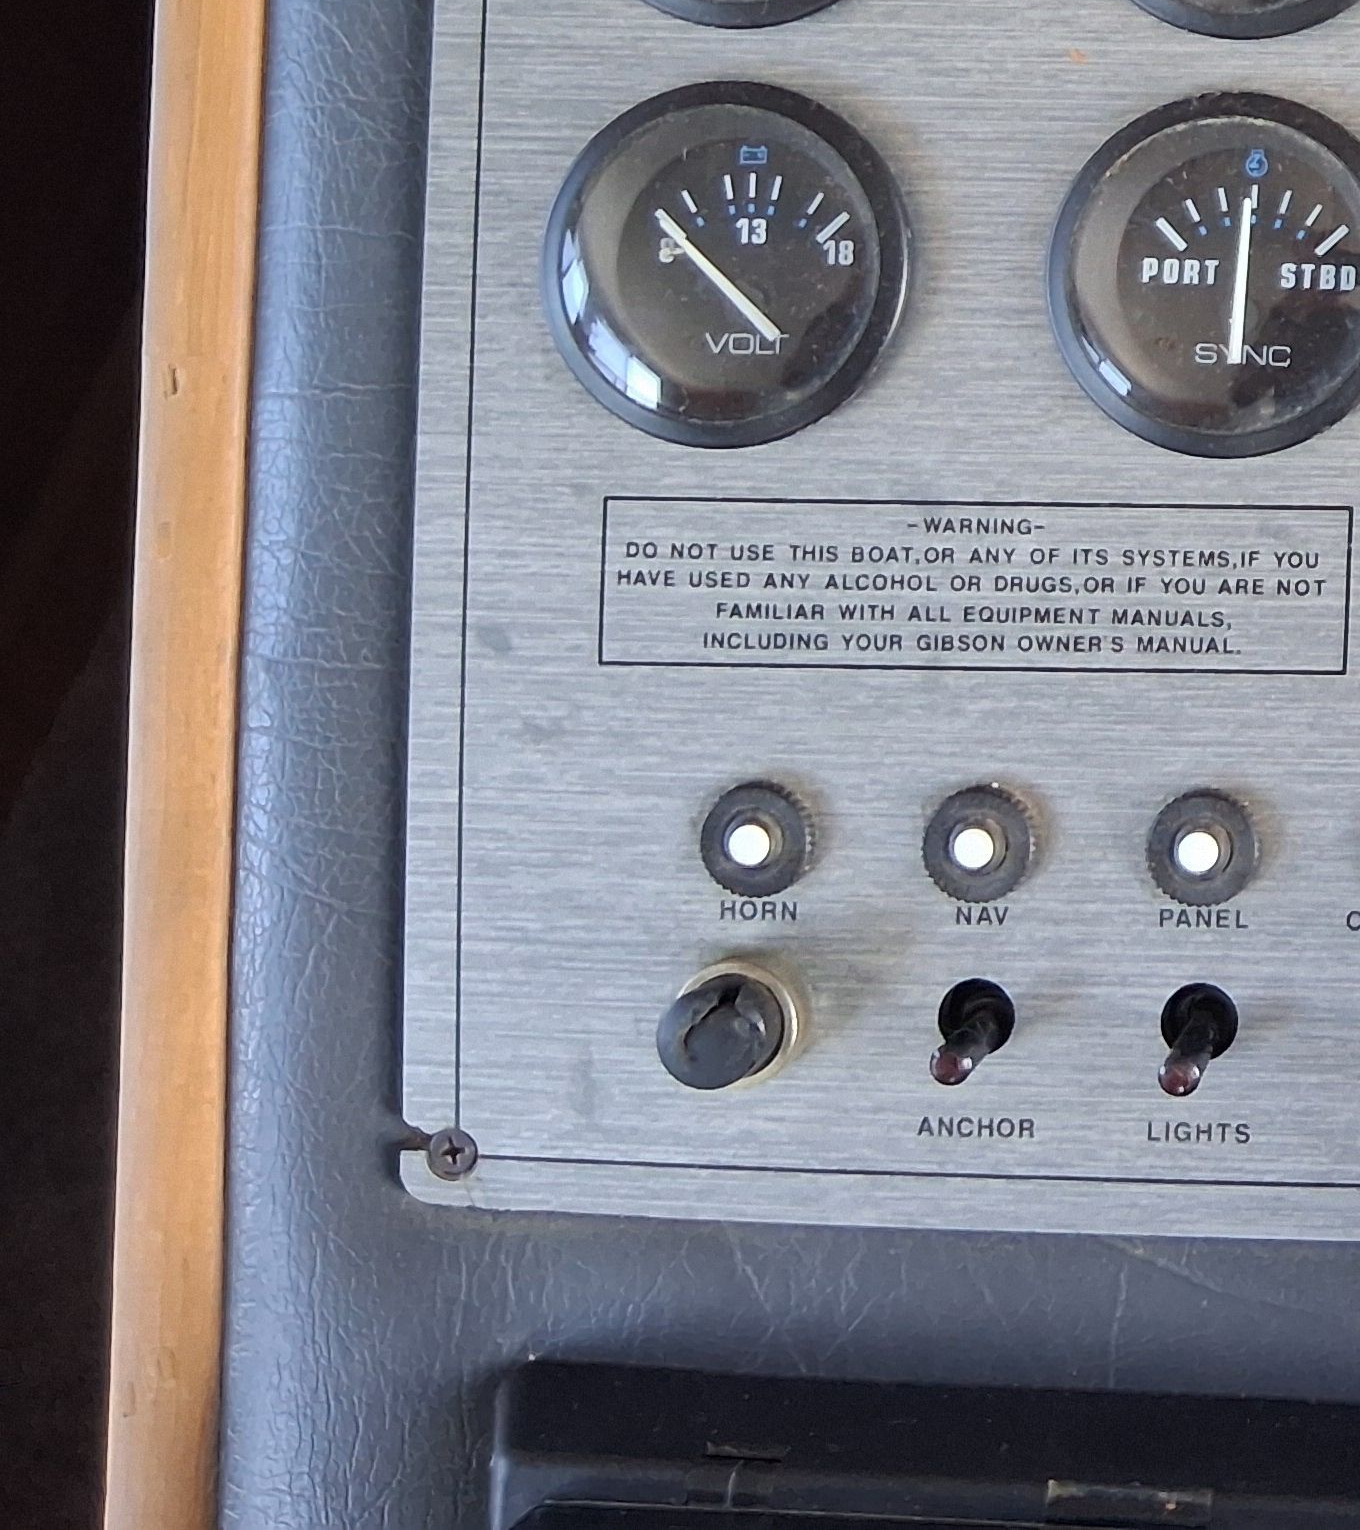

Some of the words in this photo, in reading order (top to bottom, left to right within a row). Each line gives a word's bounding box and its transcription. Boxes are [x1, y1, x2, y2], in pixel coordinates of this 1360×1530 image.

[736, 217, 767, 245] 13
[823, 239, 855, 266] 18
[1141, 257, 1220, 285] PORT
[1280, 262, 1357, 291] STBD
[705, 331, 790, 355] VOLT
[625, 541, 658, 559] DO
[670, 543, 719, 560] NOT
[730, 544, 775, 561] USE
[790, 545, 839, 563] THIS
[969, 547, 1016, 565] ANY
[1030, 548, 1060, 565] OF
[1073, 549, 1109, 566] ITS
[1274, 551, 1320, 569] YOU
[617, 570, 676, 588] HAVE
[688, 571, 751, 589] USED
[763, 573, 811, 590] ANY
[824, 574, 938, 592] ALCOHOL
[950, 575, 982, 592] OR
[1127, 577, 1147, 593] IF
[1160, 578, 1207, 595] YOU
[1217, 578, 1265, 596] ARE
[1276, 579, 1328, 597] NOT
[715, 602, 825, 621] FAMILIAR
[839, 604, 895, 621] WITH
[907, 605, 952, 623] ALL
[963, 605, 1101, 625] EQUIPMENT
[1111, 608, 1233, 630] MANUALS,
[703, 632, 829, 651] INCLUDING
[841, 634, 903, 651] YOUR
[916, 634, 1005, 653] GIBSON
[1137, 637, 1242, 655] MANUAL.
[719, 900, 798, 922] HORN
[955, 906, 1009, 926] NAV
[1158, 908, 1249, 929] PANEL
[917, 1116, 1036, 1139] ANCHOR
[1147, 1122, 1251, 1144] LIGHTS
